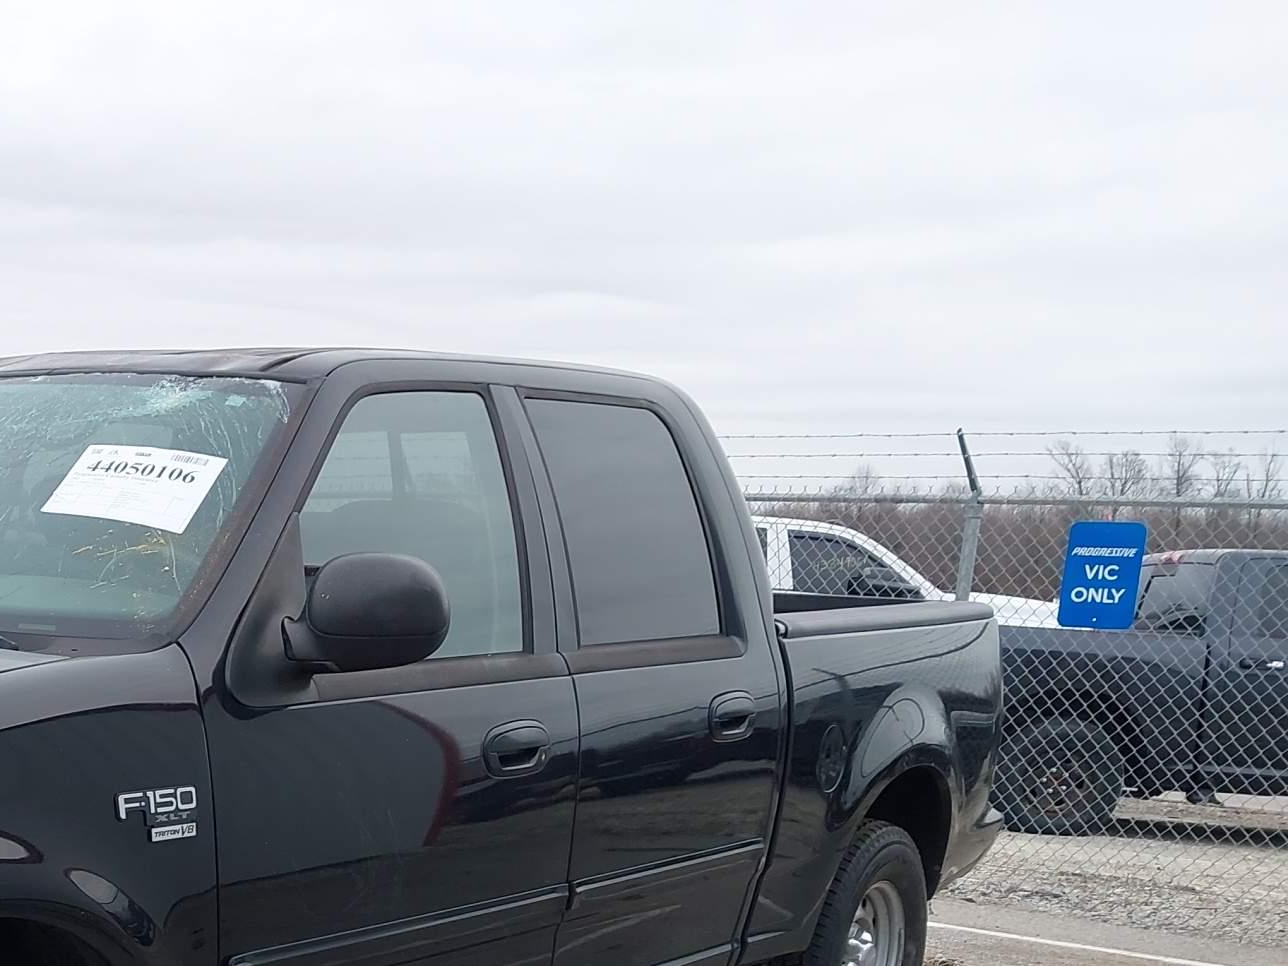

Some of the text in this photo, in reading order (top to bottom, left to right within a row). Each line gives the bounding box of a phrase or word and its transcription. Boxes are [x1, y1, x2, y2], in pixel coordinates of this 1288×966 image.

[86, 459, 201, 484] 44050106
[1071, 546, 1138, 557] PROGRESSIVE
[1085, 564, 1120, 581] VIC
[1070, 586, 1126, 604] ONLY
[154, 811, 191, 823] XLT
[154, 828, 181, 838] TRITON
